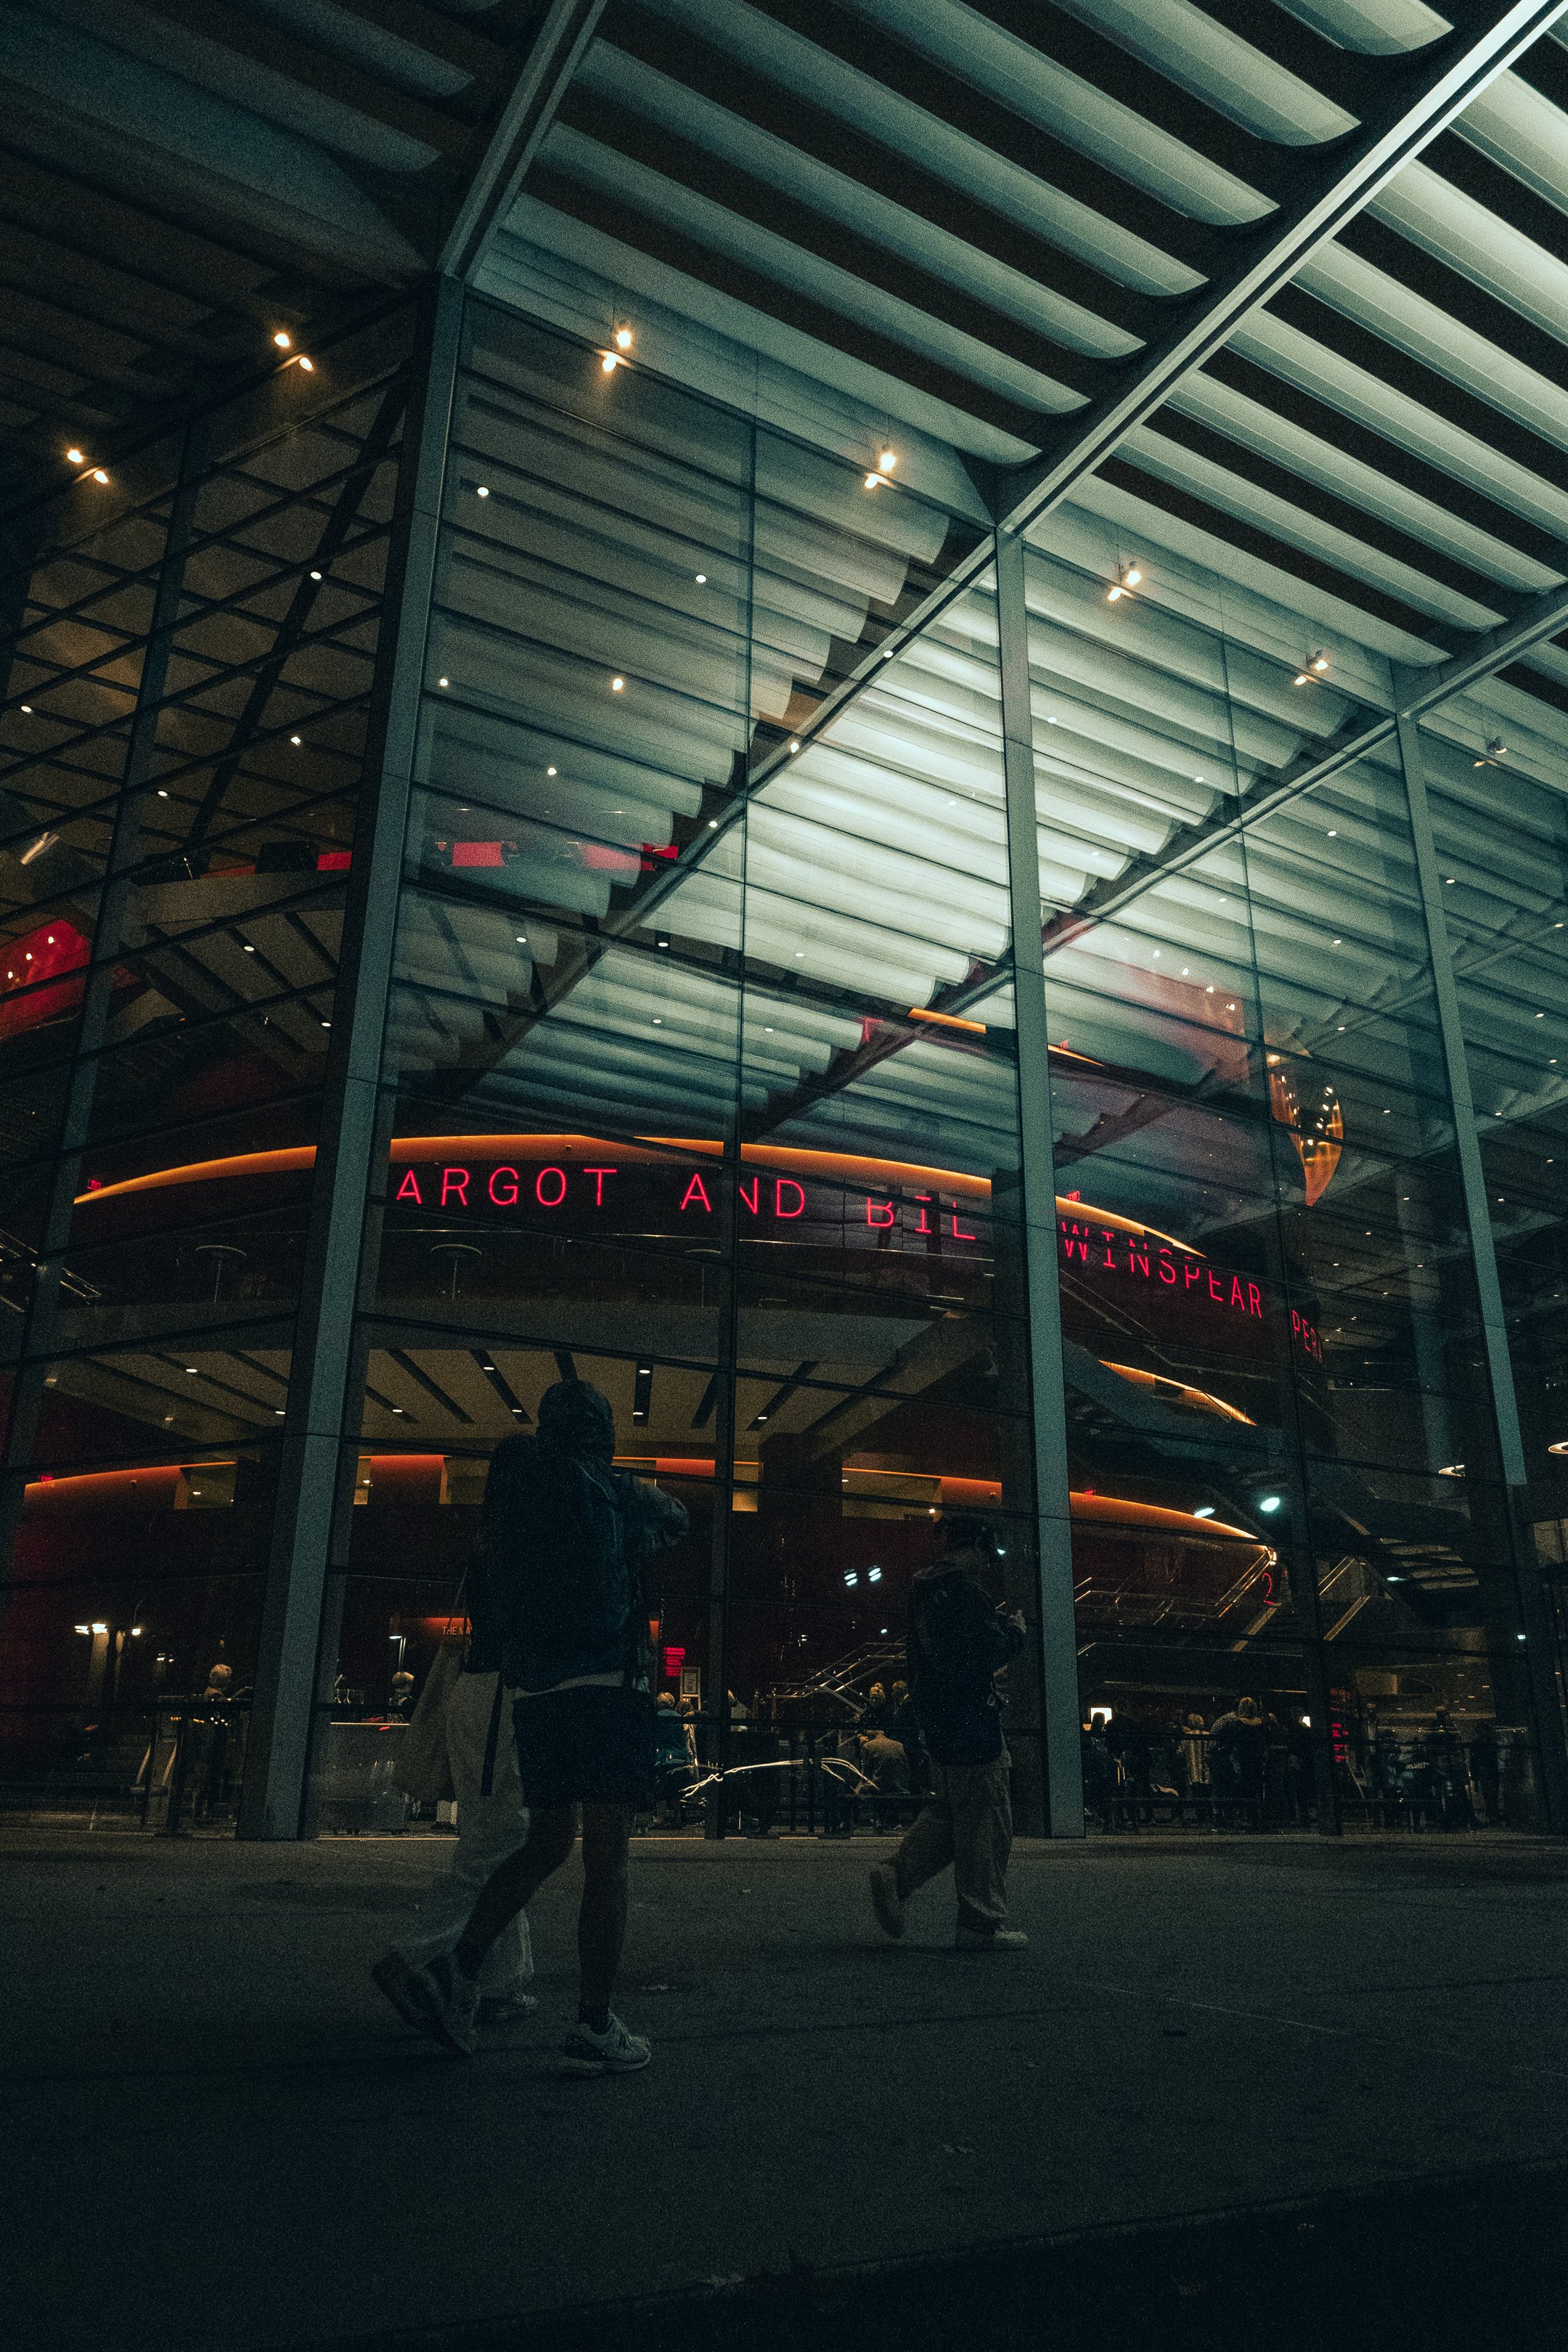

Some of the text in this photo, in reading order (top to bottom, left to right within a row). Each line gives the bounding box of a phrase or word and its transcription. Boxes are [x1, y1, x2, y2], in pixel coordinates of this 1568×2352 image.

[396, 1166, 617, 1206] ARGOT
[679, 1172, 806, 1218] AND
[1061, 1221, 1262, 1319] WINSPEAR
[442, 1626, 458, 1636] THE
